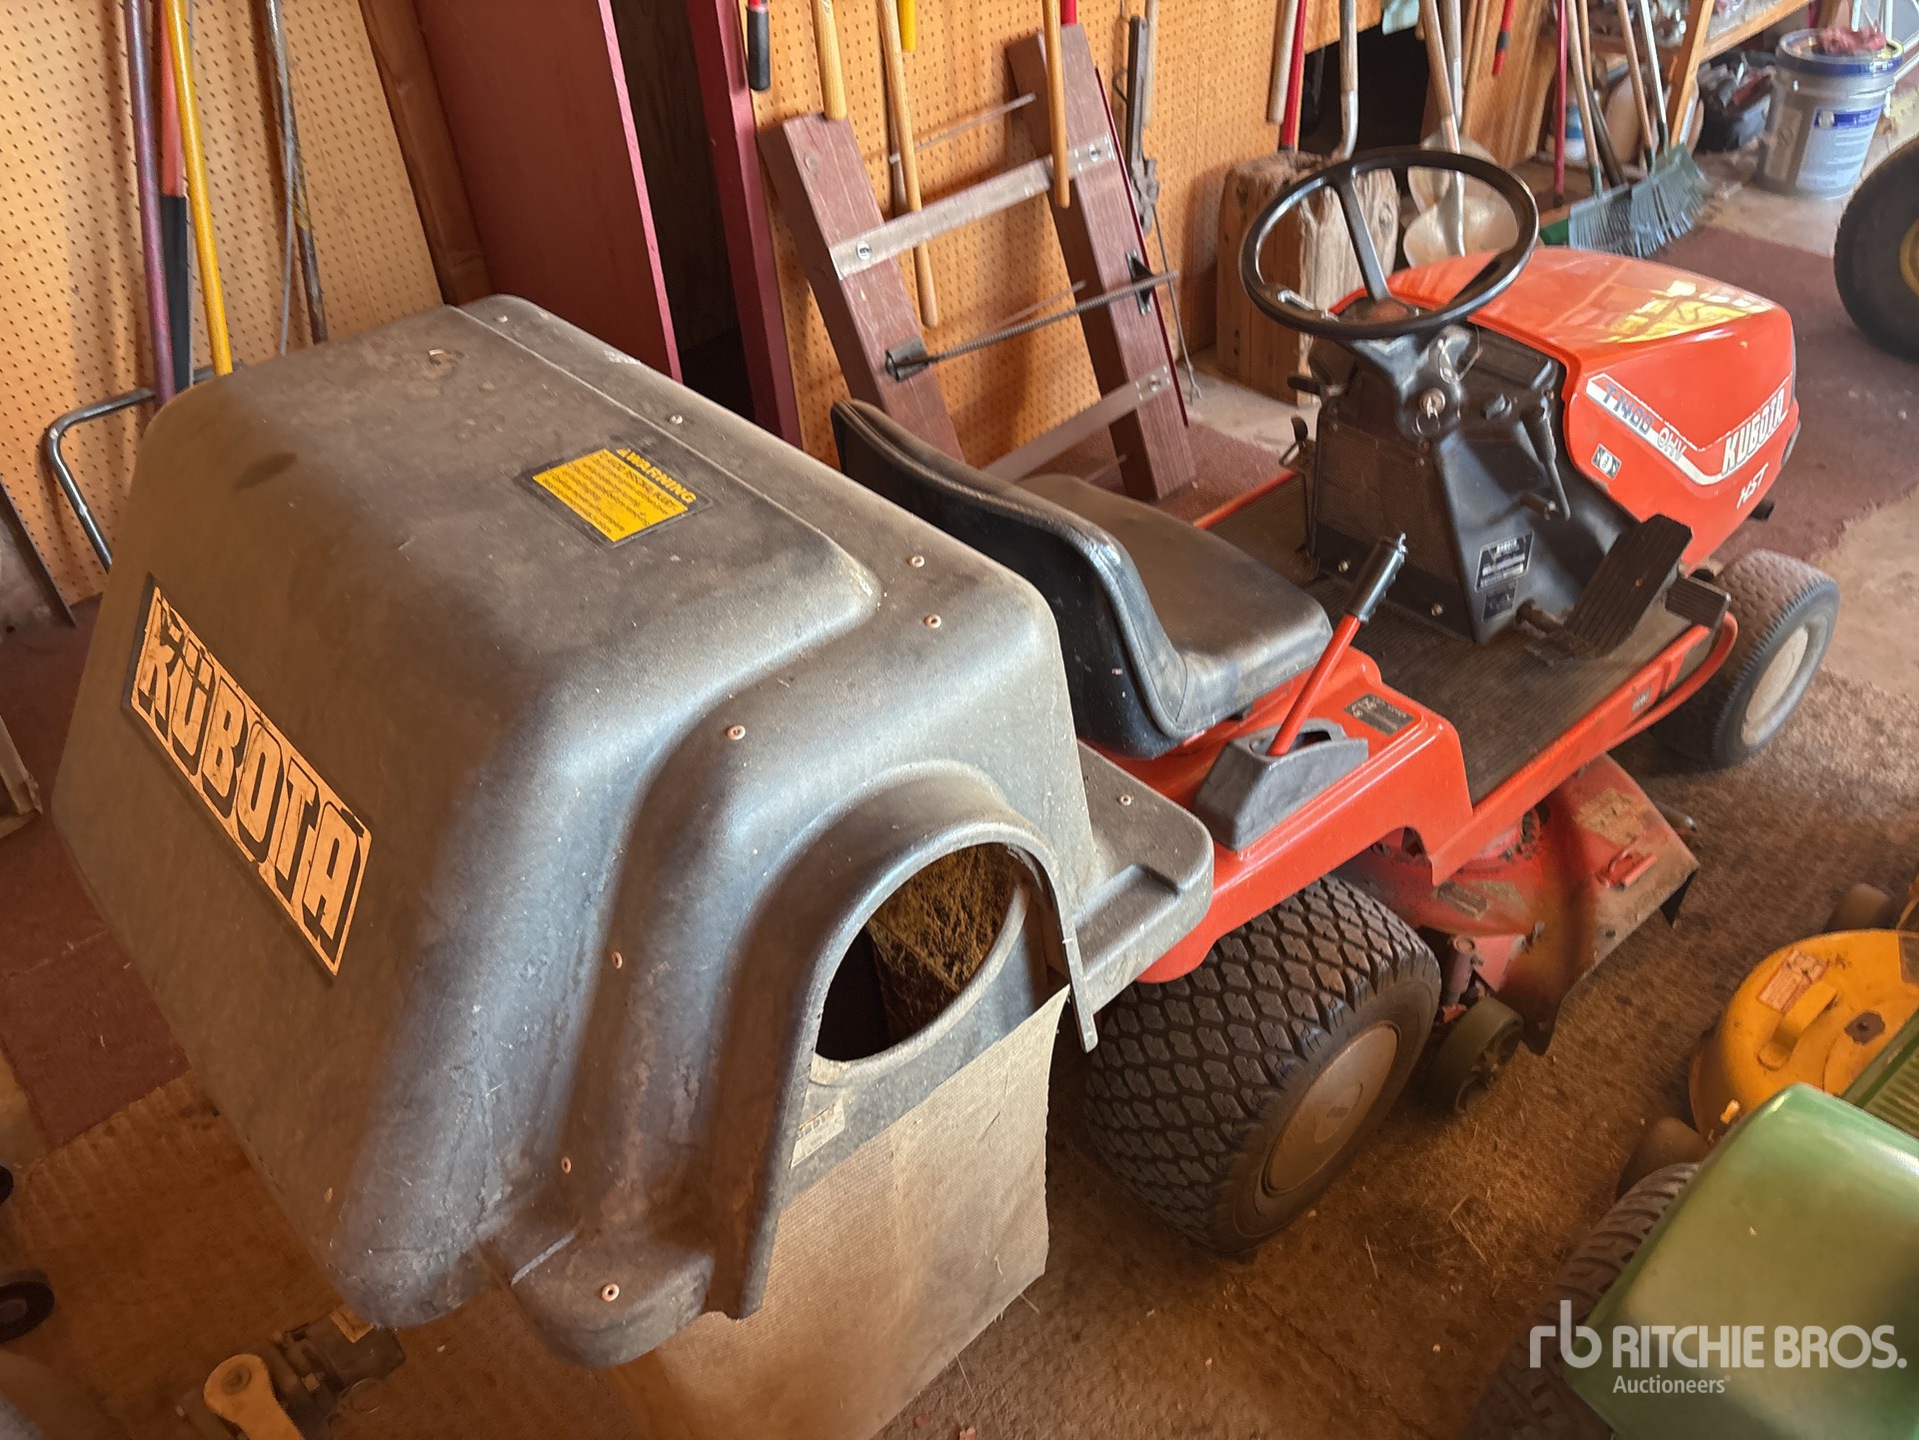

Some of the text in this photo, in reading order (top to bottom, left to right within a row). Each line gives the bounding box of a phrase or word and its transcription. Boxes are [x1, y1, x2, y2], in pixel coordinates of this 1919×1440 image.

[1721, 387, 1786, 476] KUBOTA
[626, 452, 698, 504] WARNING
[1736, 462, 1769, 509] HST
